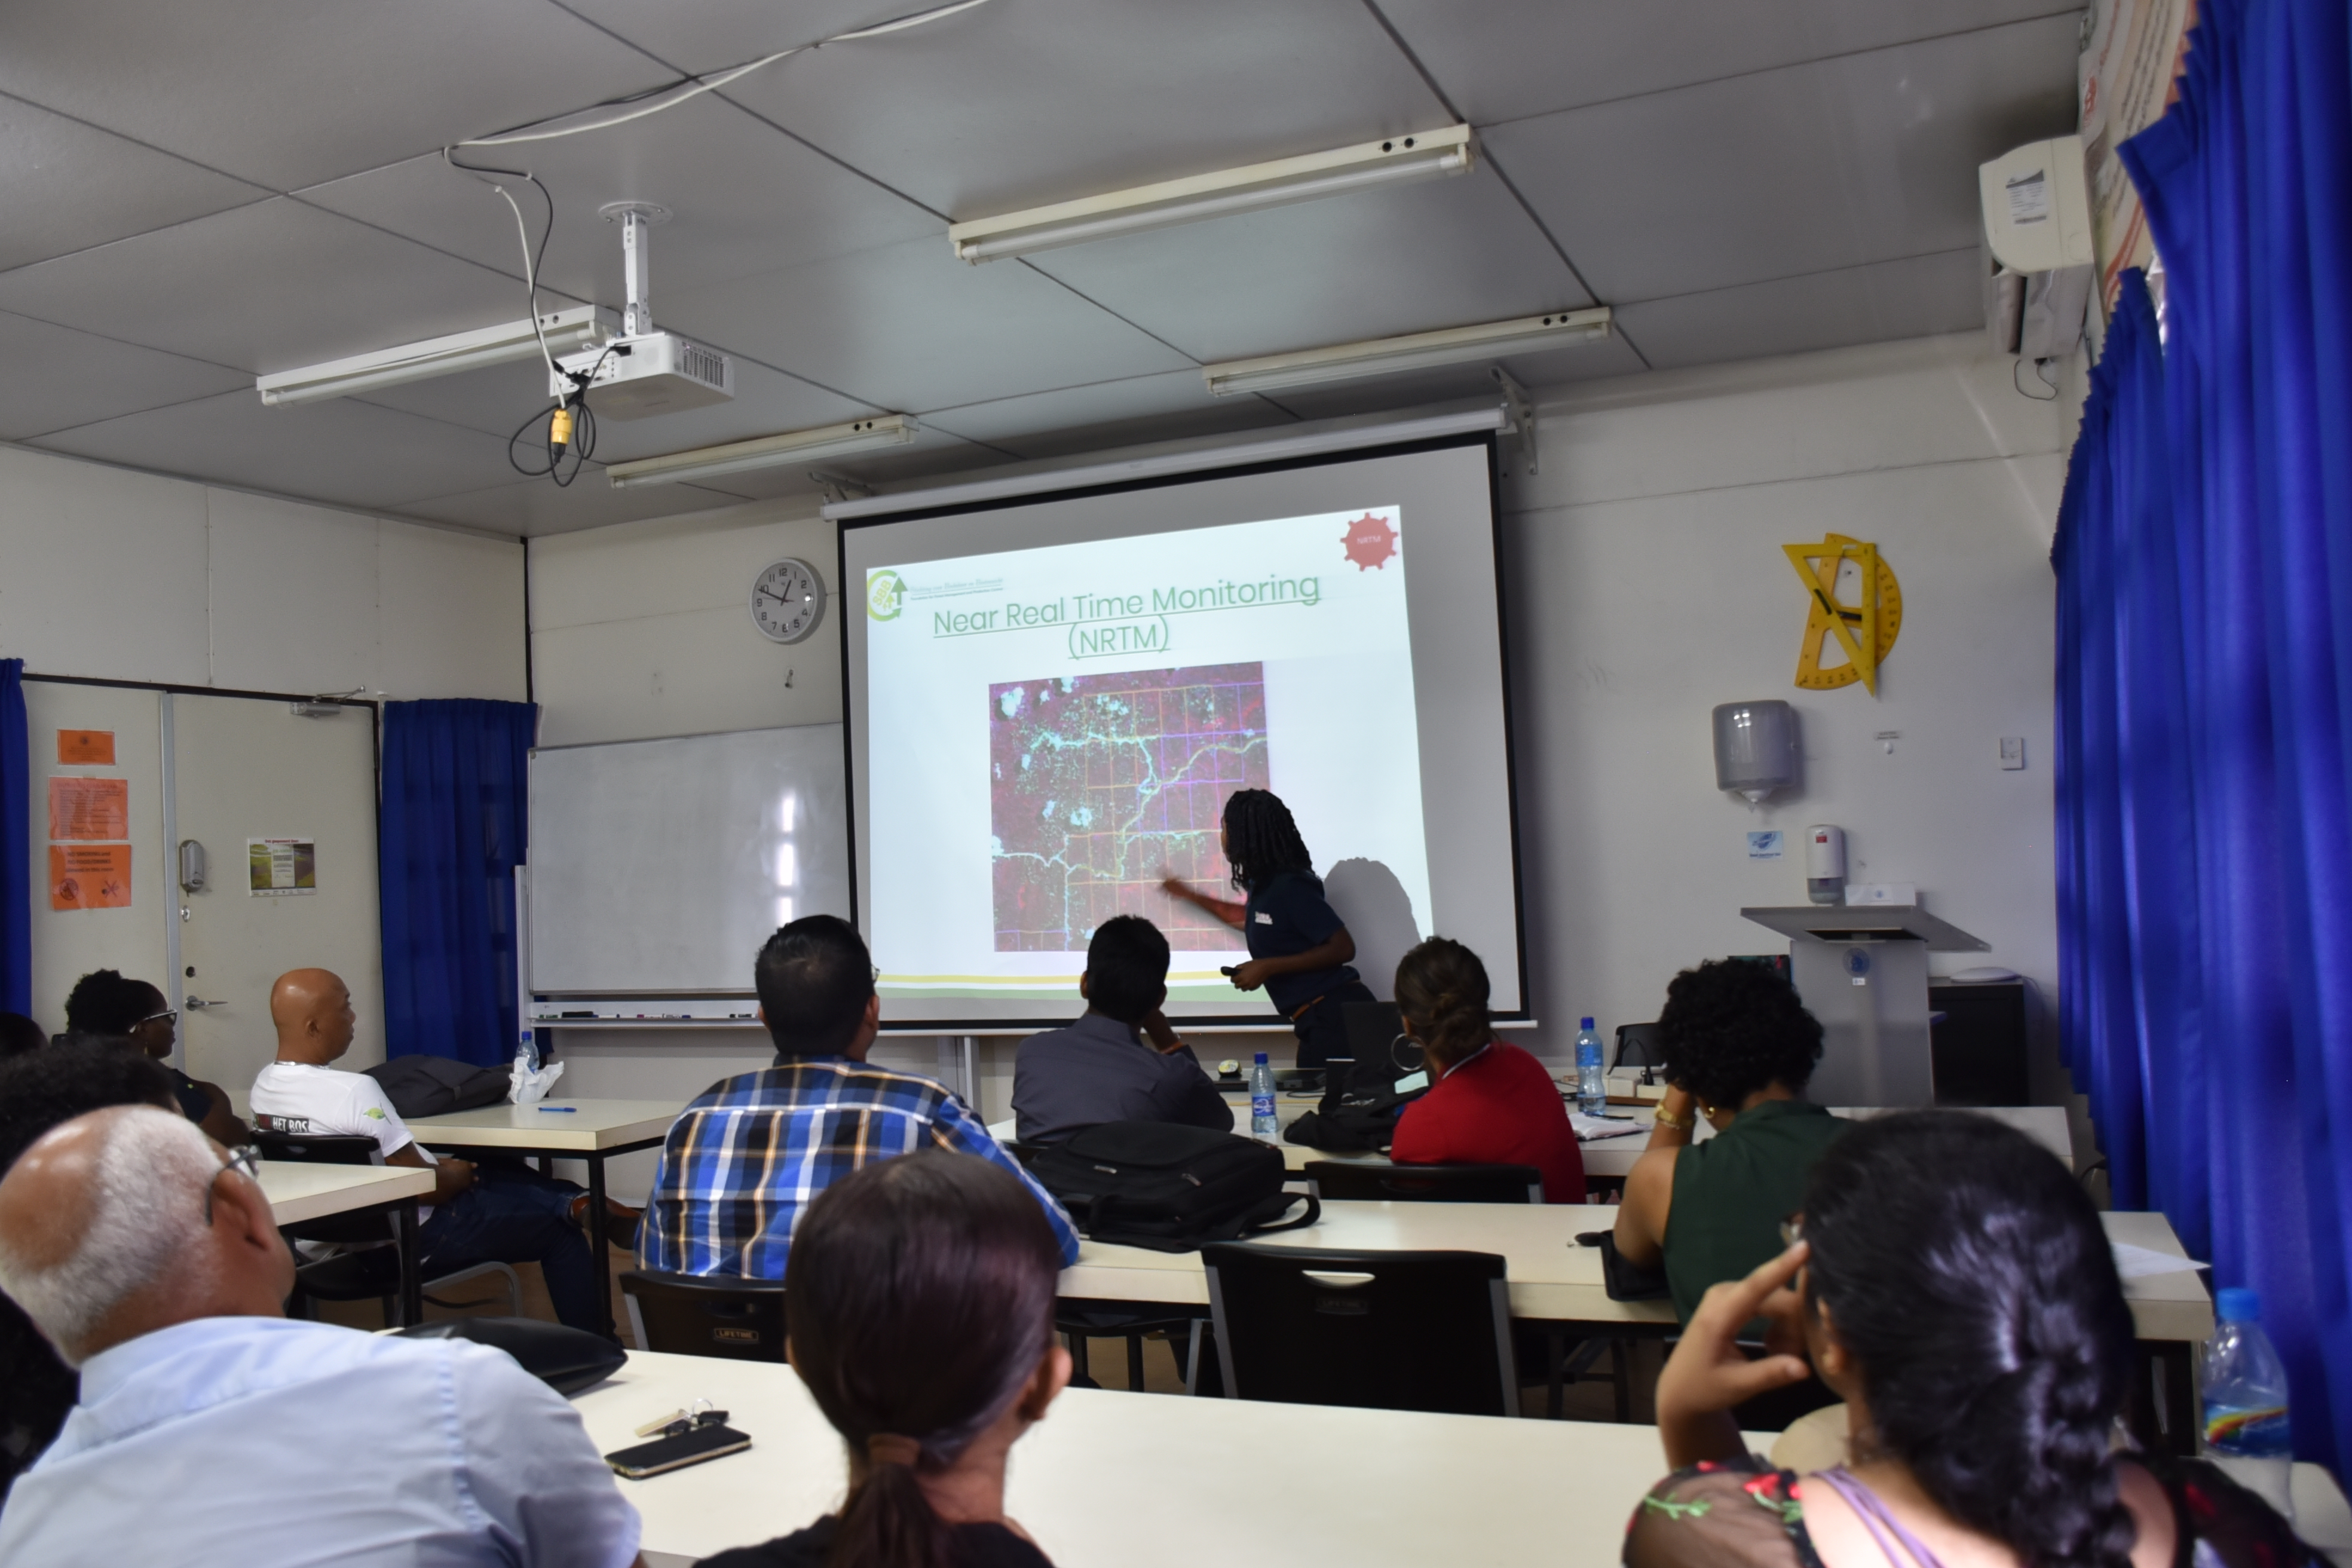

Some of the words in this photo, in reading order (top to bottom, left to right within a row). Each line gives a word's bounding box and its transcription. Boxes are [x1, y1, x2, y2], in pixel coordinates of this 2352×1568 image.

[779, 568, 788, 577] 12
[769, 574, 775, 582] 11
[801, 580, 807, 589] 2
[757, 598, 762, 607] 9
[935, 610, 999, 635] Near
[1006, 596, 1064, 627] Real
[1073, 593, 1143, 620] Time
[1153, 574, 1319, 612] Monitoring
[761, 612, 767, 620] 8
[772, 621, 777, 630] 7
[794, 619, 800, 628] 5
[782, 624, 788, 633] 6
[1068, 614, 1169, 660] (NRTM)
[273, 1116, 287, 1132] HET
[289, 1119, 308, 1132] BOS
